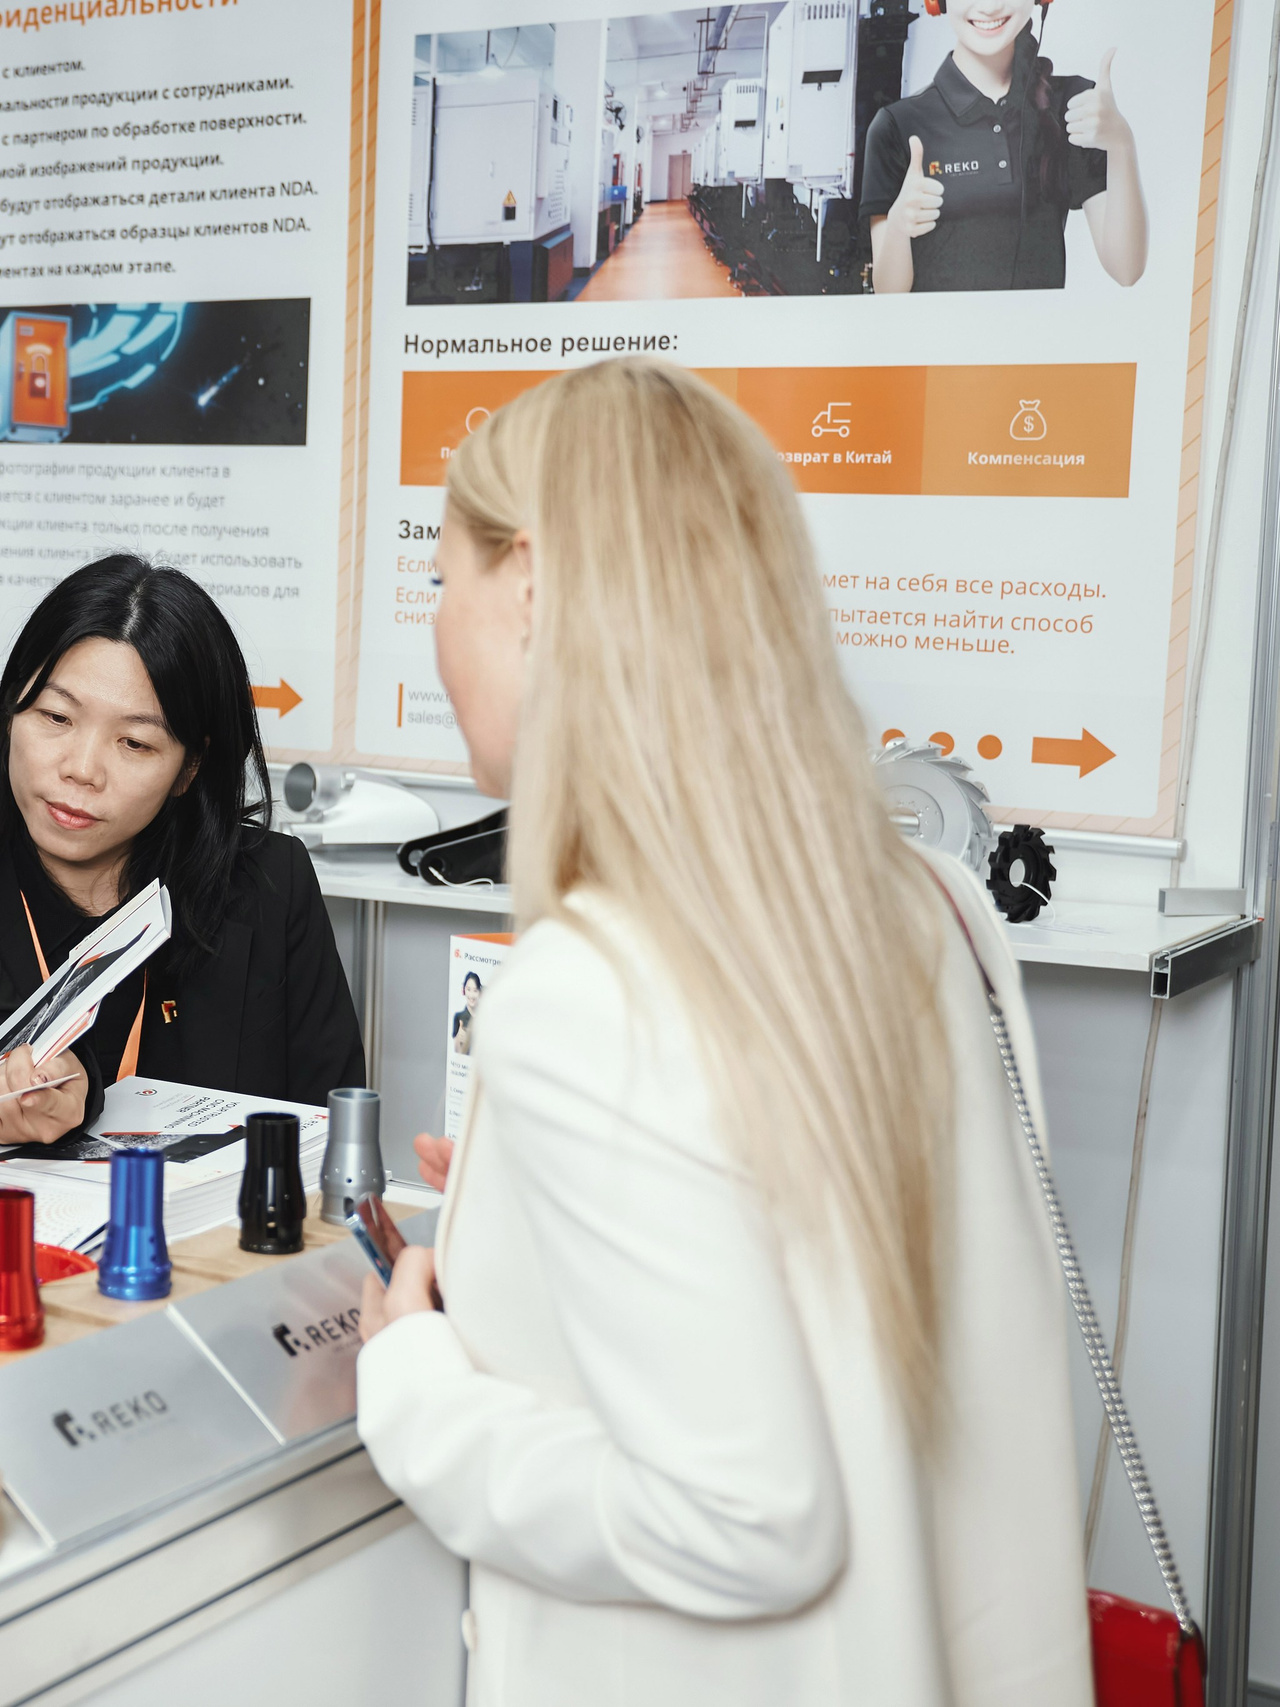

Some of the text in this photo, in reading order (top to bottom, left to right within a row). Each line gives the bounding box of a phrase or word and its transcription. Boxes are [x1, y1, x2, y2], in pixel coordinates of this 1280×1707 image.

[2, 67, 9, 79] с
[13, 60, 83, 77] клиентом.
[72, 90, 158, 107] продукции
[162, 87, 169, 99] с
[173, 78, 292, 99] сотрудниками.
[2, 134, 9, 146] с
[13, 128, 88, 146] партнером
[91, 126, 109, 138] по
[113, 120, 196, 138] обработке
[199, 113, 305, 131] поверхности.
[29, 157, 128, 177] изображений
[131, 155, 222, 172] продукции.
[944, 160, 979, 174] REKO
[0, 198, 40, 215] будут
[44, 193, 145, 209] отображаться
[148, 190, 206, 206] детали
[209, 186, 276, 200] клиента
[280, 180, 316, 196] NDA.
[19, 228, 116, 244] отображаться
[120, 224, 190, 241] образцы
[194, 222, 269, 235] клиентов
[273, 217, 309, 232] NDA.
[47, 265, 63, 276] на
[65, 262, 124, 276] каждом
[127, 261, 174, 273] этапе.
[403, 333, 679, 359] Нормальное решение:
[833, 454, 842, 464] в
[845, 449, 893, 465] Китай
[967, 451, 1086, 468] Компенсация
[78, 464, 156, 479] продукции
[160, 465, 220, 477] клиента
[222, 466, 231, 477] в
[34, 490, 41, 503] с
[43, 491, 107, 504] клиентом
[109, 493, 170, 507] заранее
[173, 495, 184, 506] и
[186, 491, 226, 509] будет
[36, 520, 89, 532] клиента
[92, 521, 143, 536] только
[142, 522, 188, 536] после
[191, 524, 270, 538] получения
[36, 547, 88, 562] клиента
[200, 553, 303, 568] использовать
[396, 556, 438, 573] Если
[273, 585, 300, 600] для
[395, 586, 437, 604] Если
[865, 576, 890, 591] на
[896, 573, 949, 593] себя
[955, 579, 994, 595] все
[1000, 579, 1107, 601] расходы.
[934, 610, 1004, 630] найти
[1010, 614, 1095, 634] способ
[835, 631, 1016, 654] можно меньше.
[93, 1390, 170, 1434] REKO
